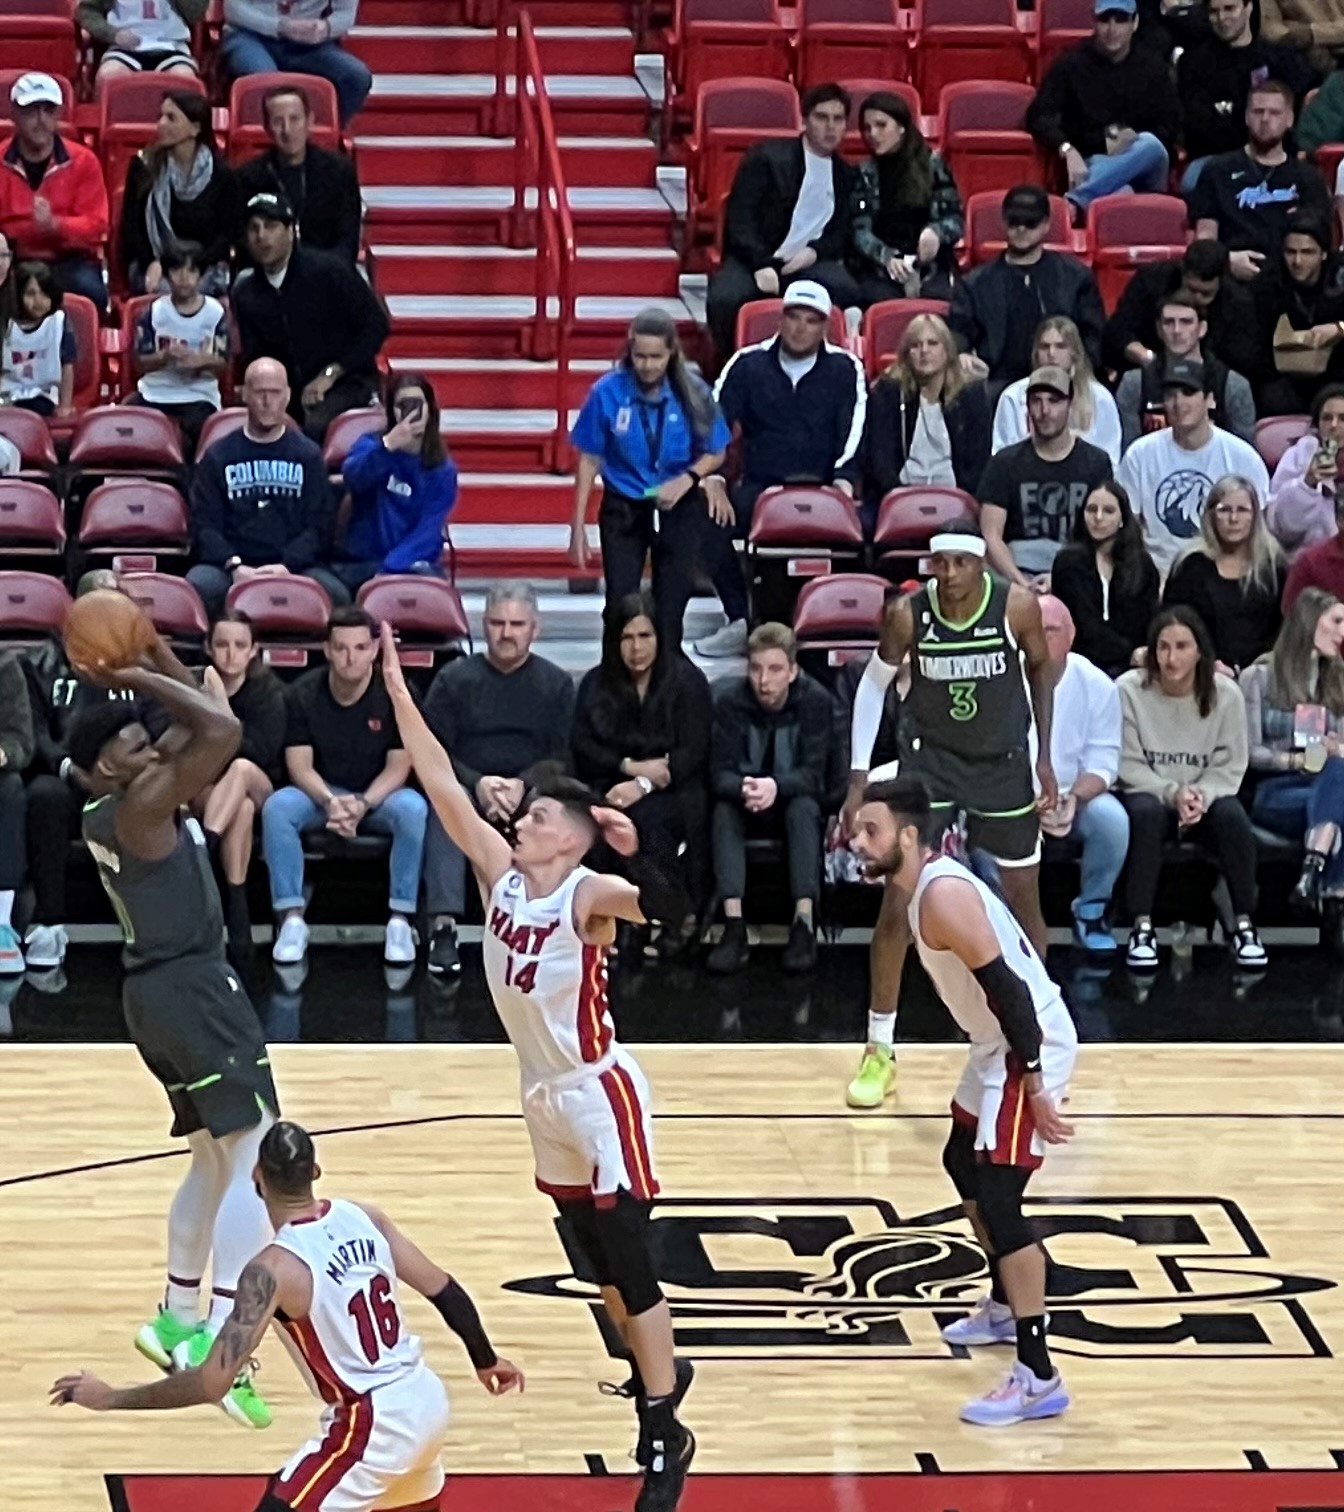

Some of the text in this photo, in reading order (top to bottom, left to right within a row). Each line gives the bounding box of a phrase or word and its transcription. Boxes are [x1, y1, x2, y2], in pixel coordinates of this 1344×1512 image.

[225, 460, 304, 487] COLUMBIA
[949, 682, 978, 720] 3
[490, 906, 560, 956] HEAT
[505, 955, 539, 994] 14
[326, 1238, 377, 1286] MARTIN
[348, 1274, 400, 1365] 16
